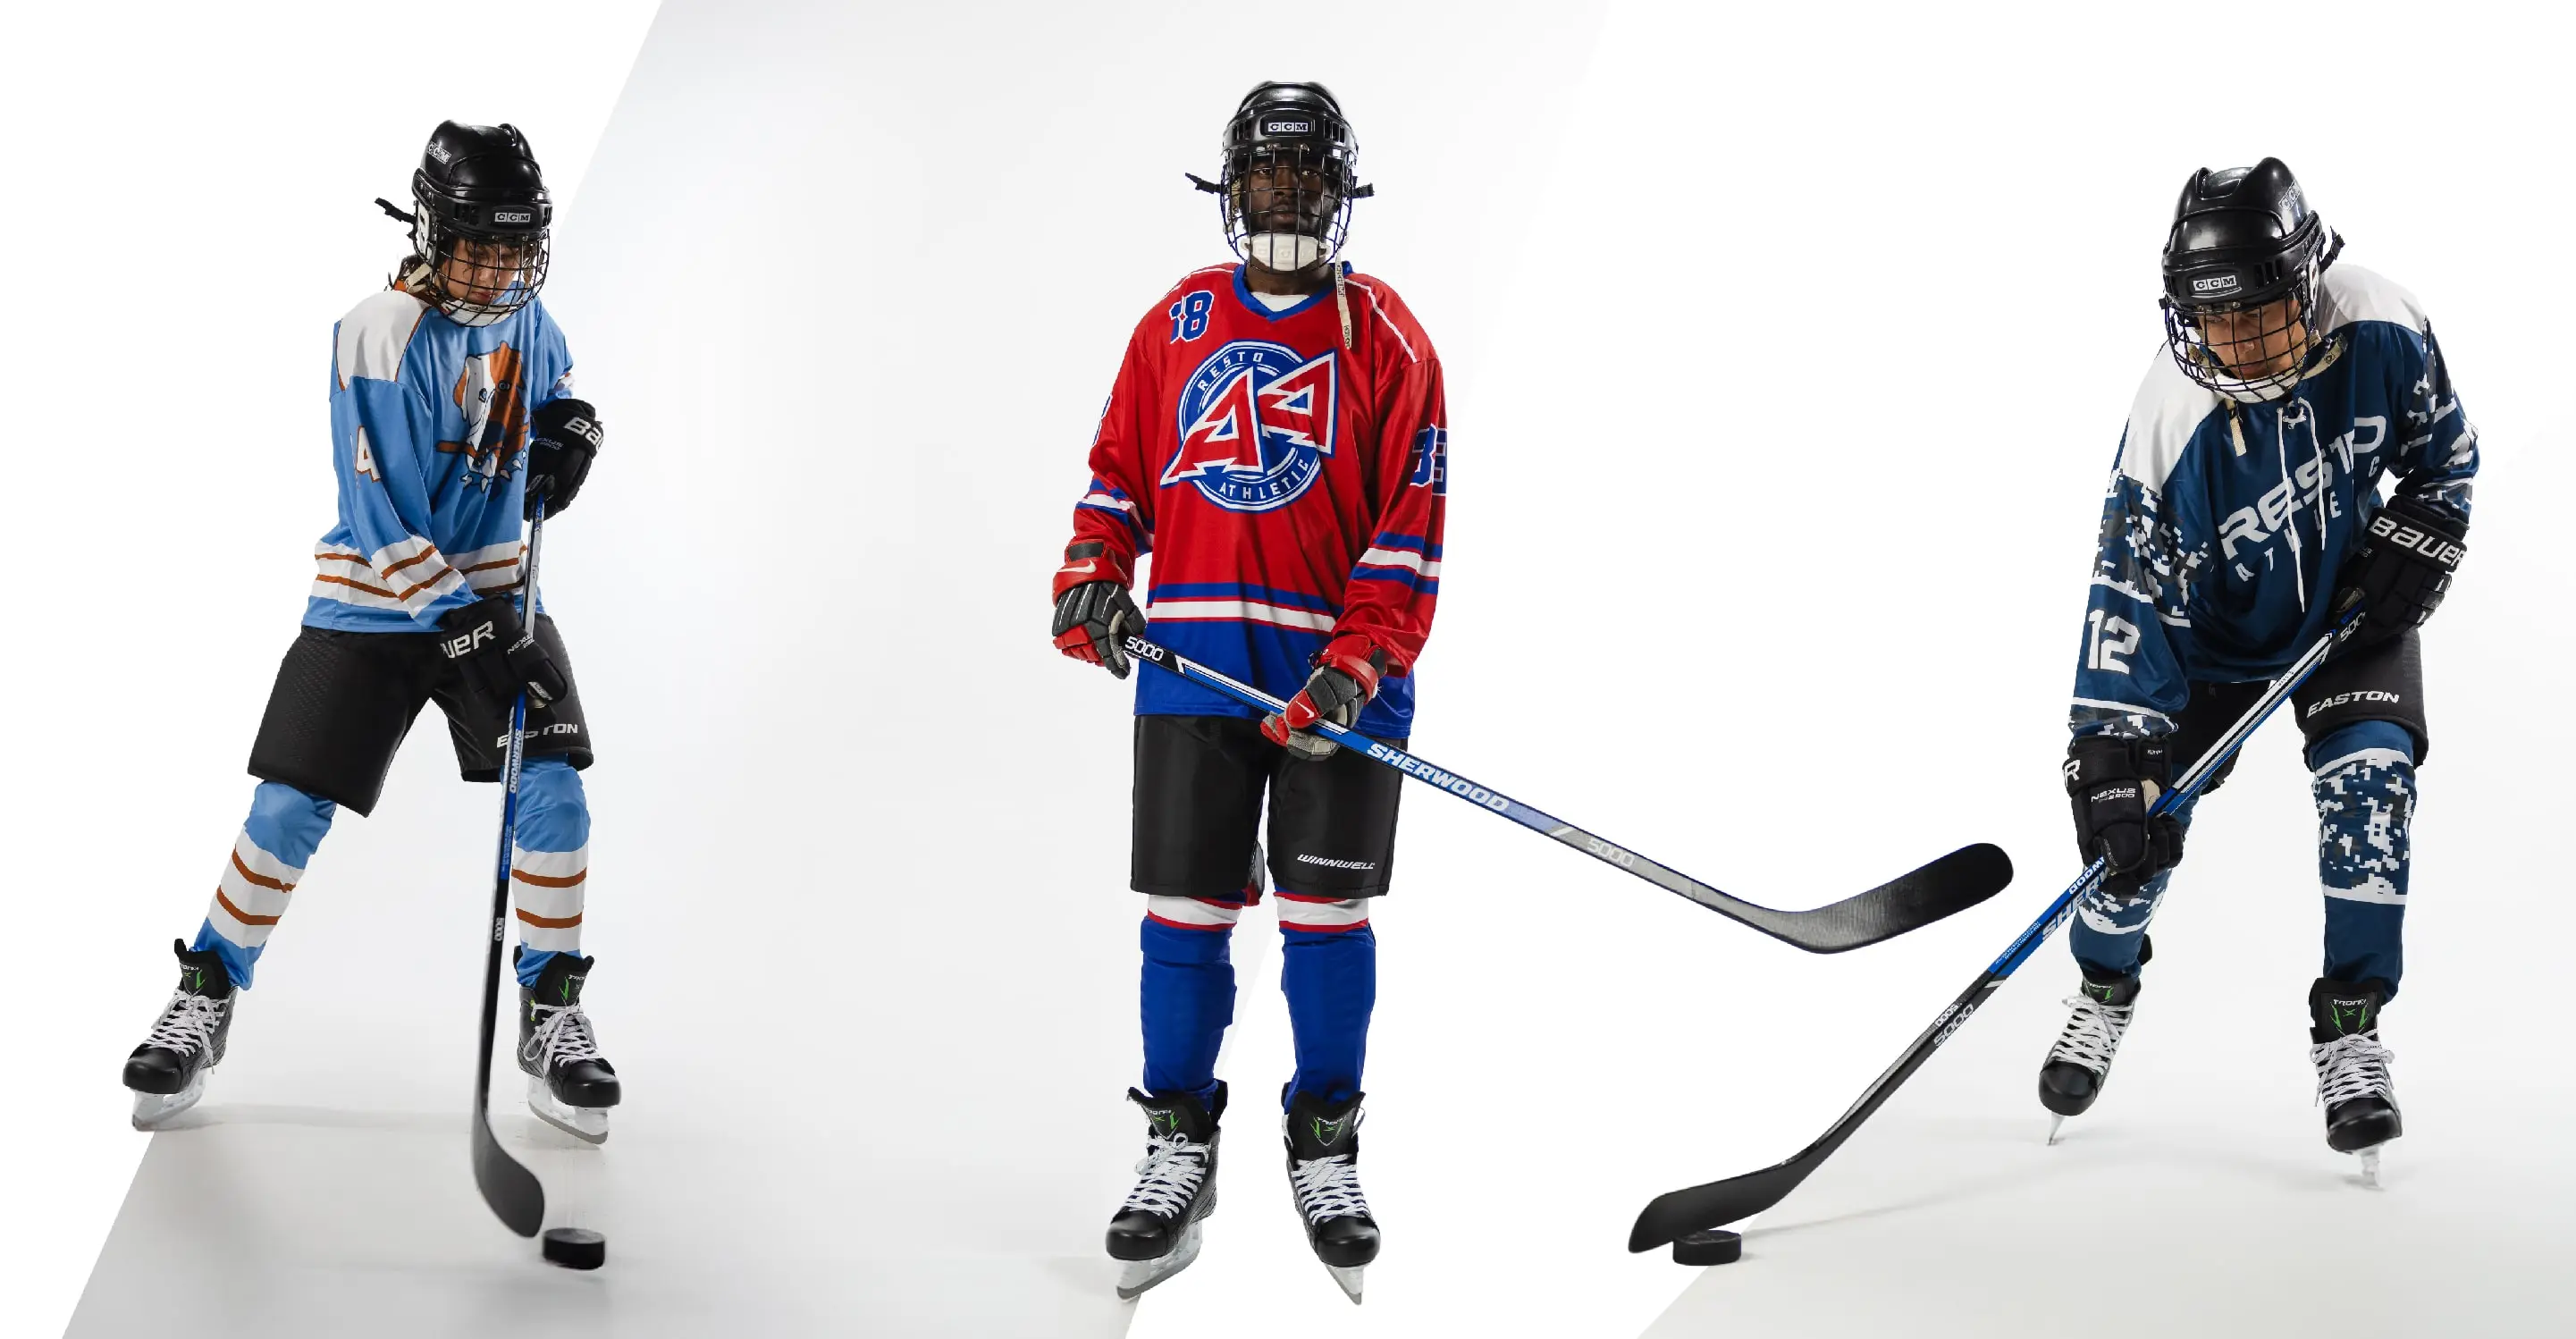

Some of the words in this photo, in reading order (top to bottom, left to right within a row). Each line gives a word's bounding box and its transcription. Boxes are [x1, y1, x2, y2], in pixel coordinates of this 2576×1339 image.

[1269, 122, 1308, 132] CCM
[495, 213, 531, 223] CCM
[2193, 275, 2236, 291] CCM
[1198, 351, 1263, 391] RESTO
[1219, 459, 1309, 500] ATHLETIC
[2340, 611, 2366, 642] 500
[1124, 636, 1165, 661] 5000
[2087, 609, 2141, 675] 12
[2307, 690, 2400, 719] EASTON
[497, 723, 577, 748] ESTON
[509, 728, 523, 794] SHERWOOD
[1367, 743, 1510, 812] SHERWOOD
[2091, 787, 2136, 803] NEXUS
[1297, 854, 1375, 870] WINNWELL
[1587, 838, 1636, 867] 5000
[2069, 856, 2105, 895] WOOD
[1933, 1003, 1974, 1047] 5000
